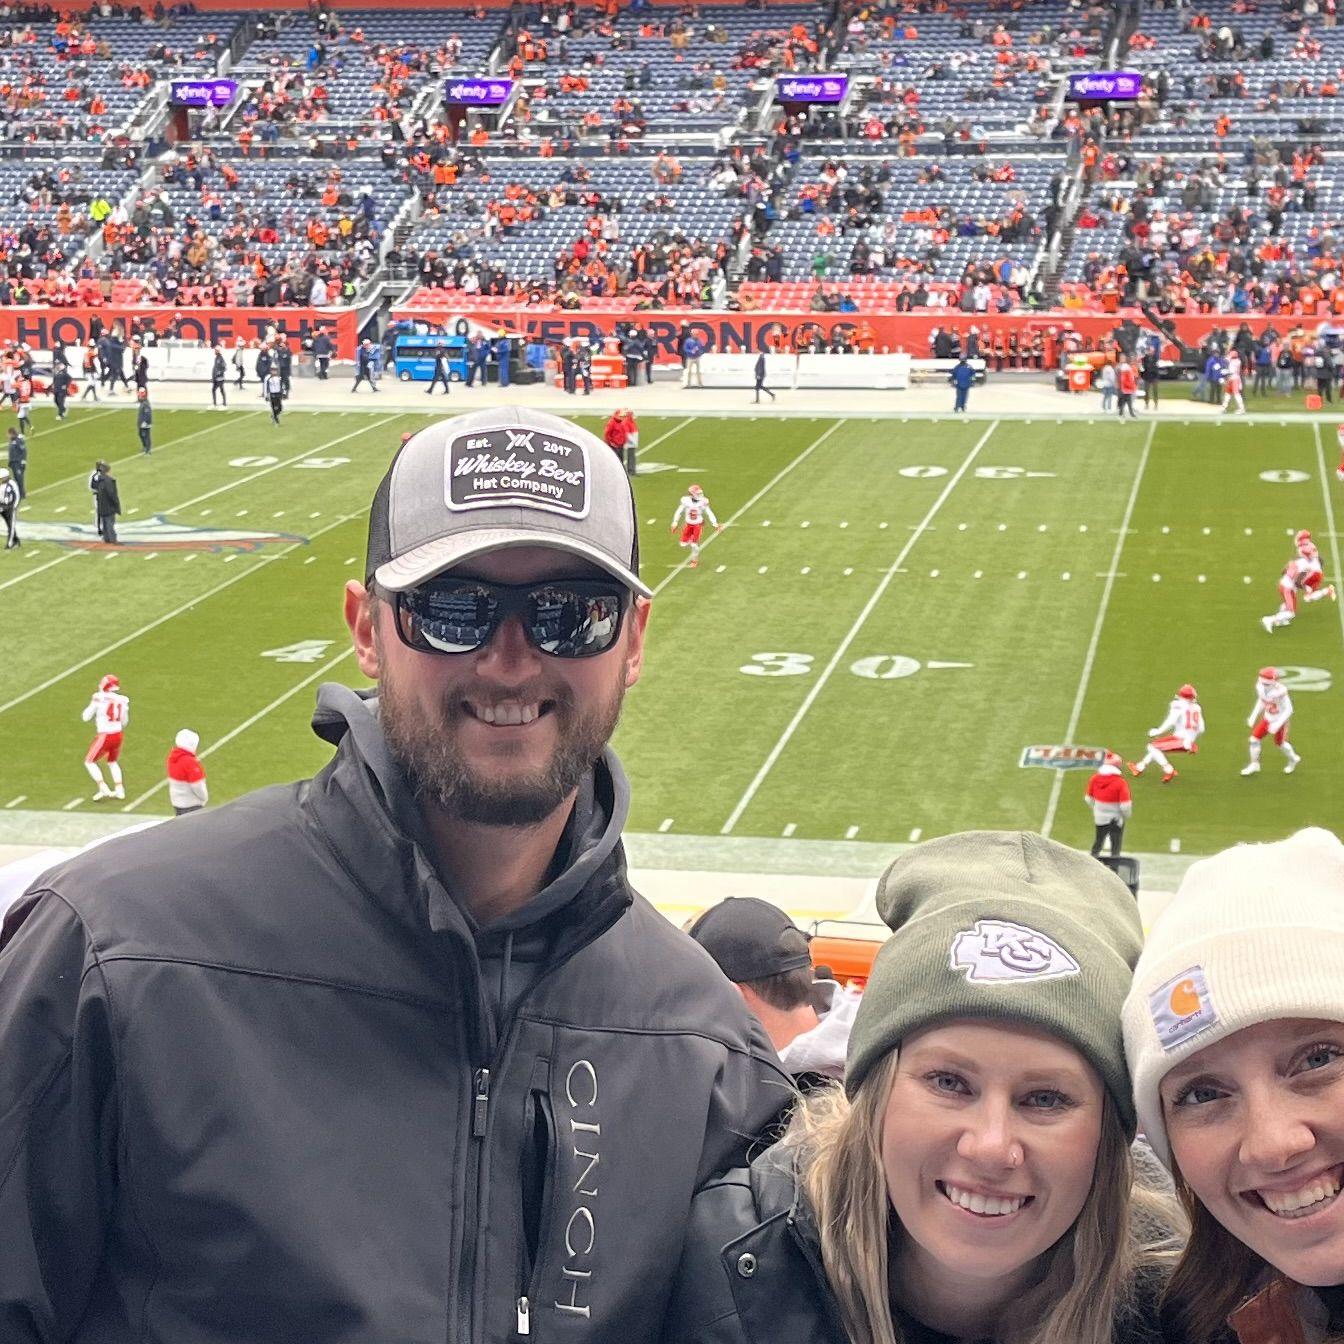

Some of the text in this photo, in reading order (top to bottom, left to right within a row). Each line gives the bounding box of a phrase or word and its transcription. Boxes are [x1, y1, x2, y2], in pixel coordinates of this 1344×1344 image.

[466, 438, 492, 451] Est.
[454, 453, 585, 486] Whiskey Bent
[473, 476, 564, 498] Hat Company
[739, 650, 923, 680] 30
[105, 702, 122, 722] 41
[553, 1059, 601, 1320] CINCH
